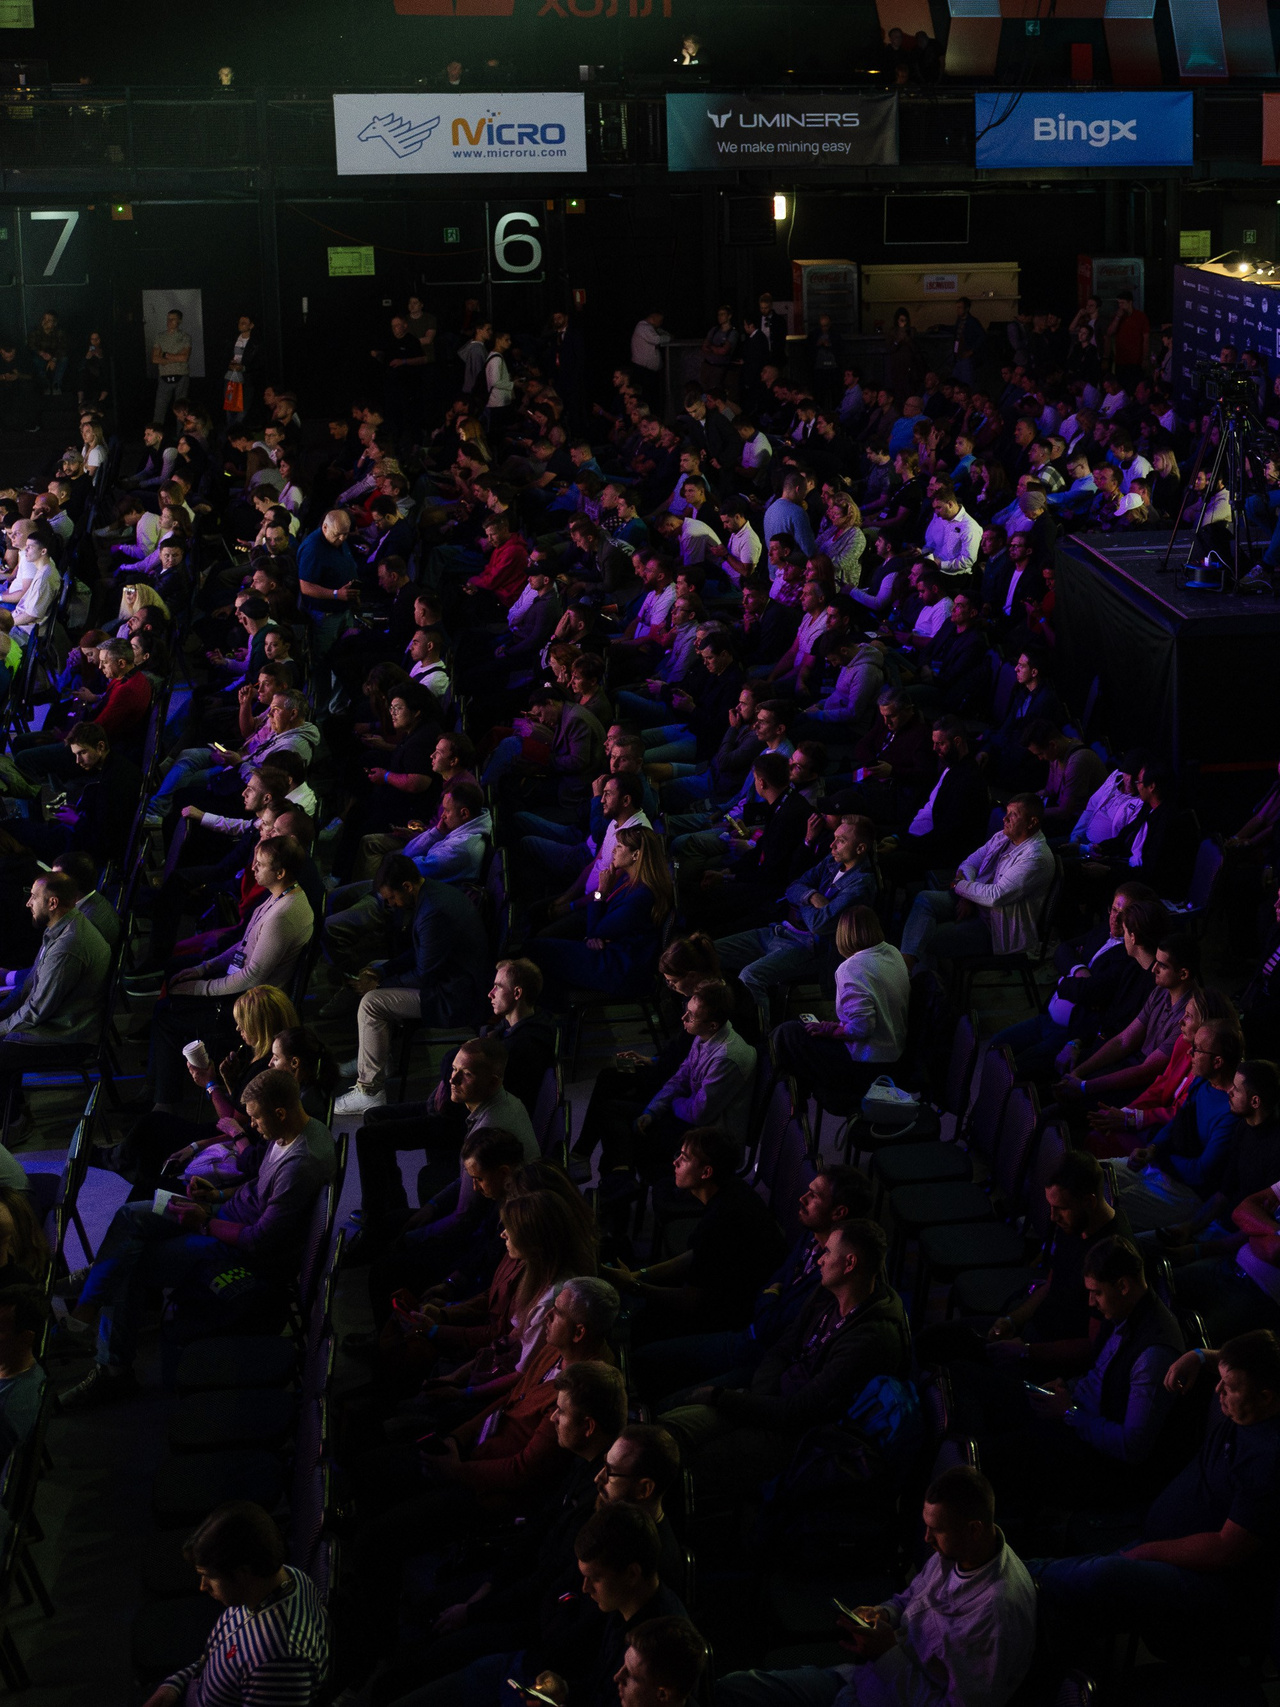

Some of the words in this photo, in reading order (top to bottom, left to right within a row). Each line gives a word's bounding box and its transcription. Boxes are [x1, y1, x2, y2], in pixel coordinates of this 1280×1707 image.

[739, 113, 860, 128] UMINERS
[452, 148, 567, 158] www.microru.com
[717, 141, 738, 153] We
[740, 141, 774, 153] make
[777, 141, 819, 155] mining
[822, 142, 851, 154] easy
[31, 212, 79, 276] 7
[494, 212, 543, 273] 6
